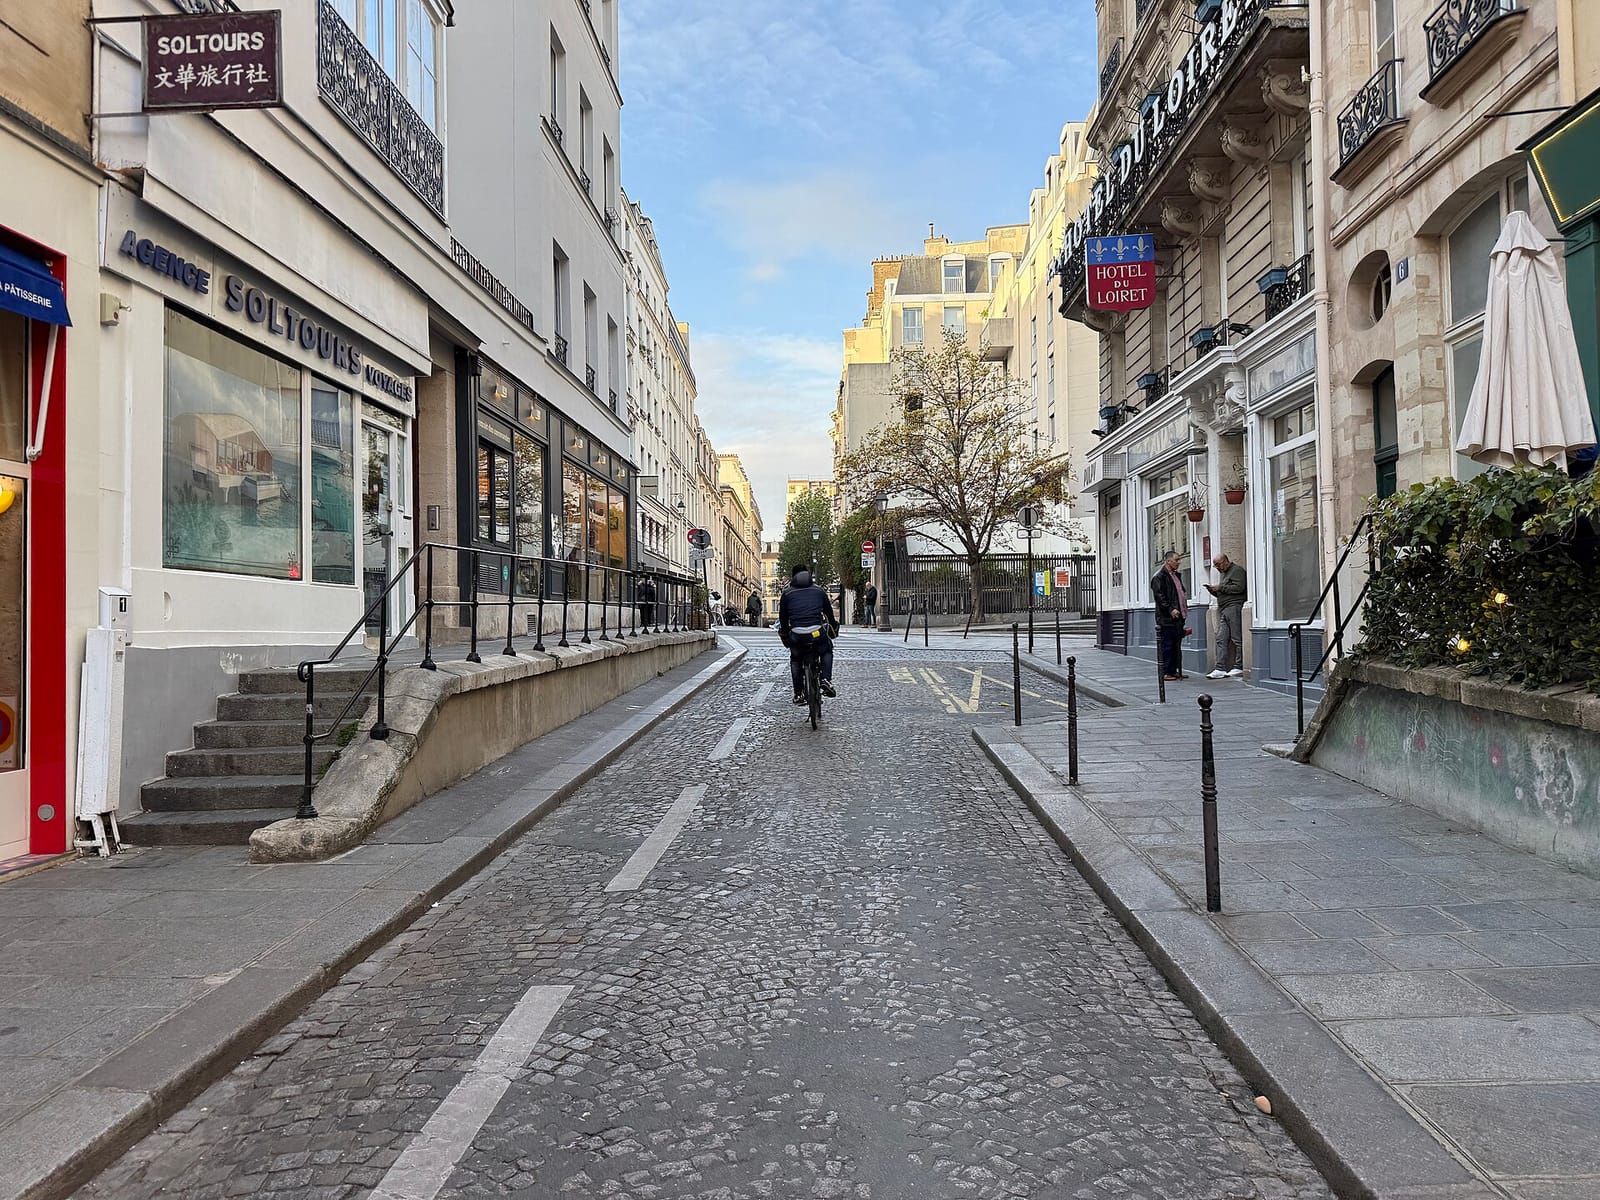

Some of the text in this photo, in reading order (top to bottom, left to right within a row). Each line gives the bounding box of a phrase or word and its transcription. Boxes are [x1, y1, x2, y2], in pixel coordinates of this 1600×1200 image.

[157, 31, 265, 55] SOLTOURS
[154, 63, 270, 93] 文華旅行社
[1119, 116, 1145, 186] DU
[1152, 0, 1254, 139] LOIRE
[1096, 264, 1147, 280] HOTEL
[1398, 261, 1405, 280] 6
[1114, 280, 1129, 288] DU
[4, 283, 53, 308] PÂTISSERIE
[1097, 289, 1148, 304] LOIRET
[119, 229, 211, 295] AGENCE
[224, 275, 362, 374] SOLTOURS
[365, 363, 413, 402] VOYAGES
[120, 598, 125, 612] 1
